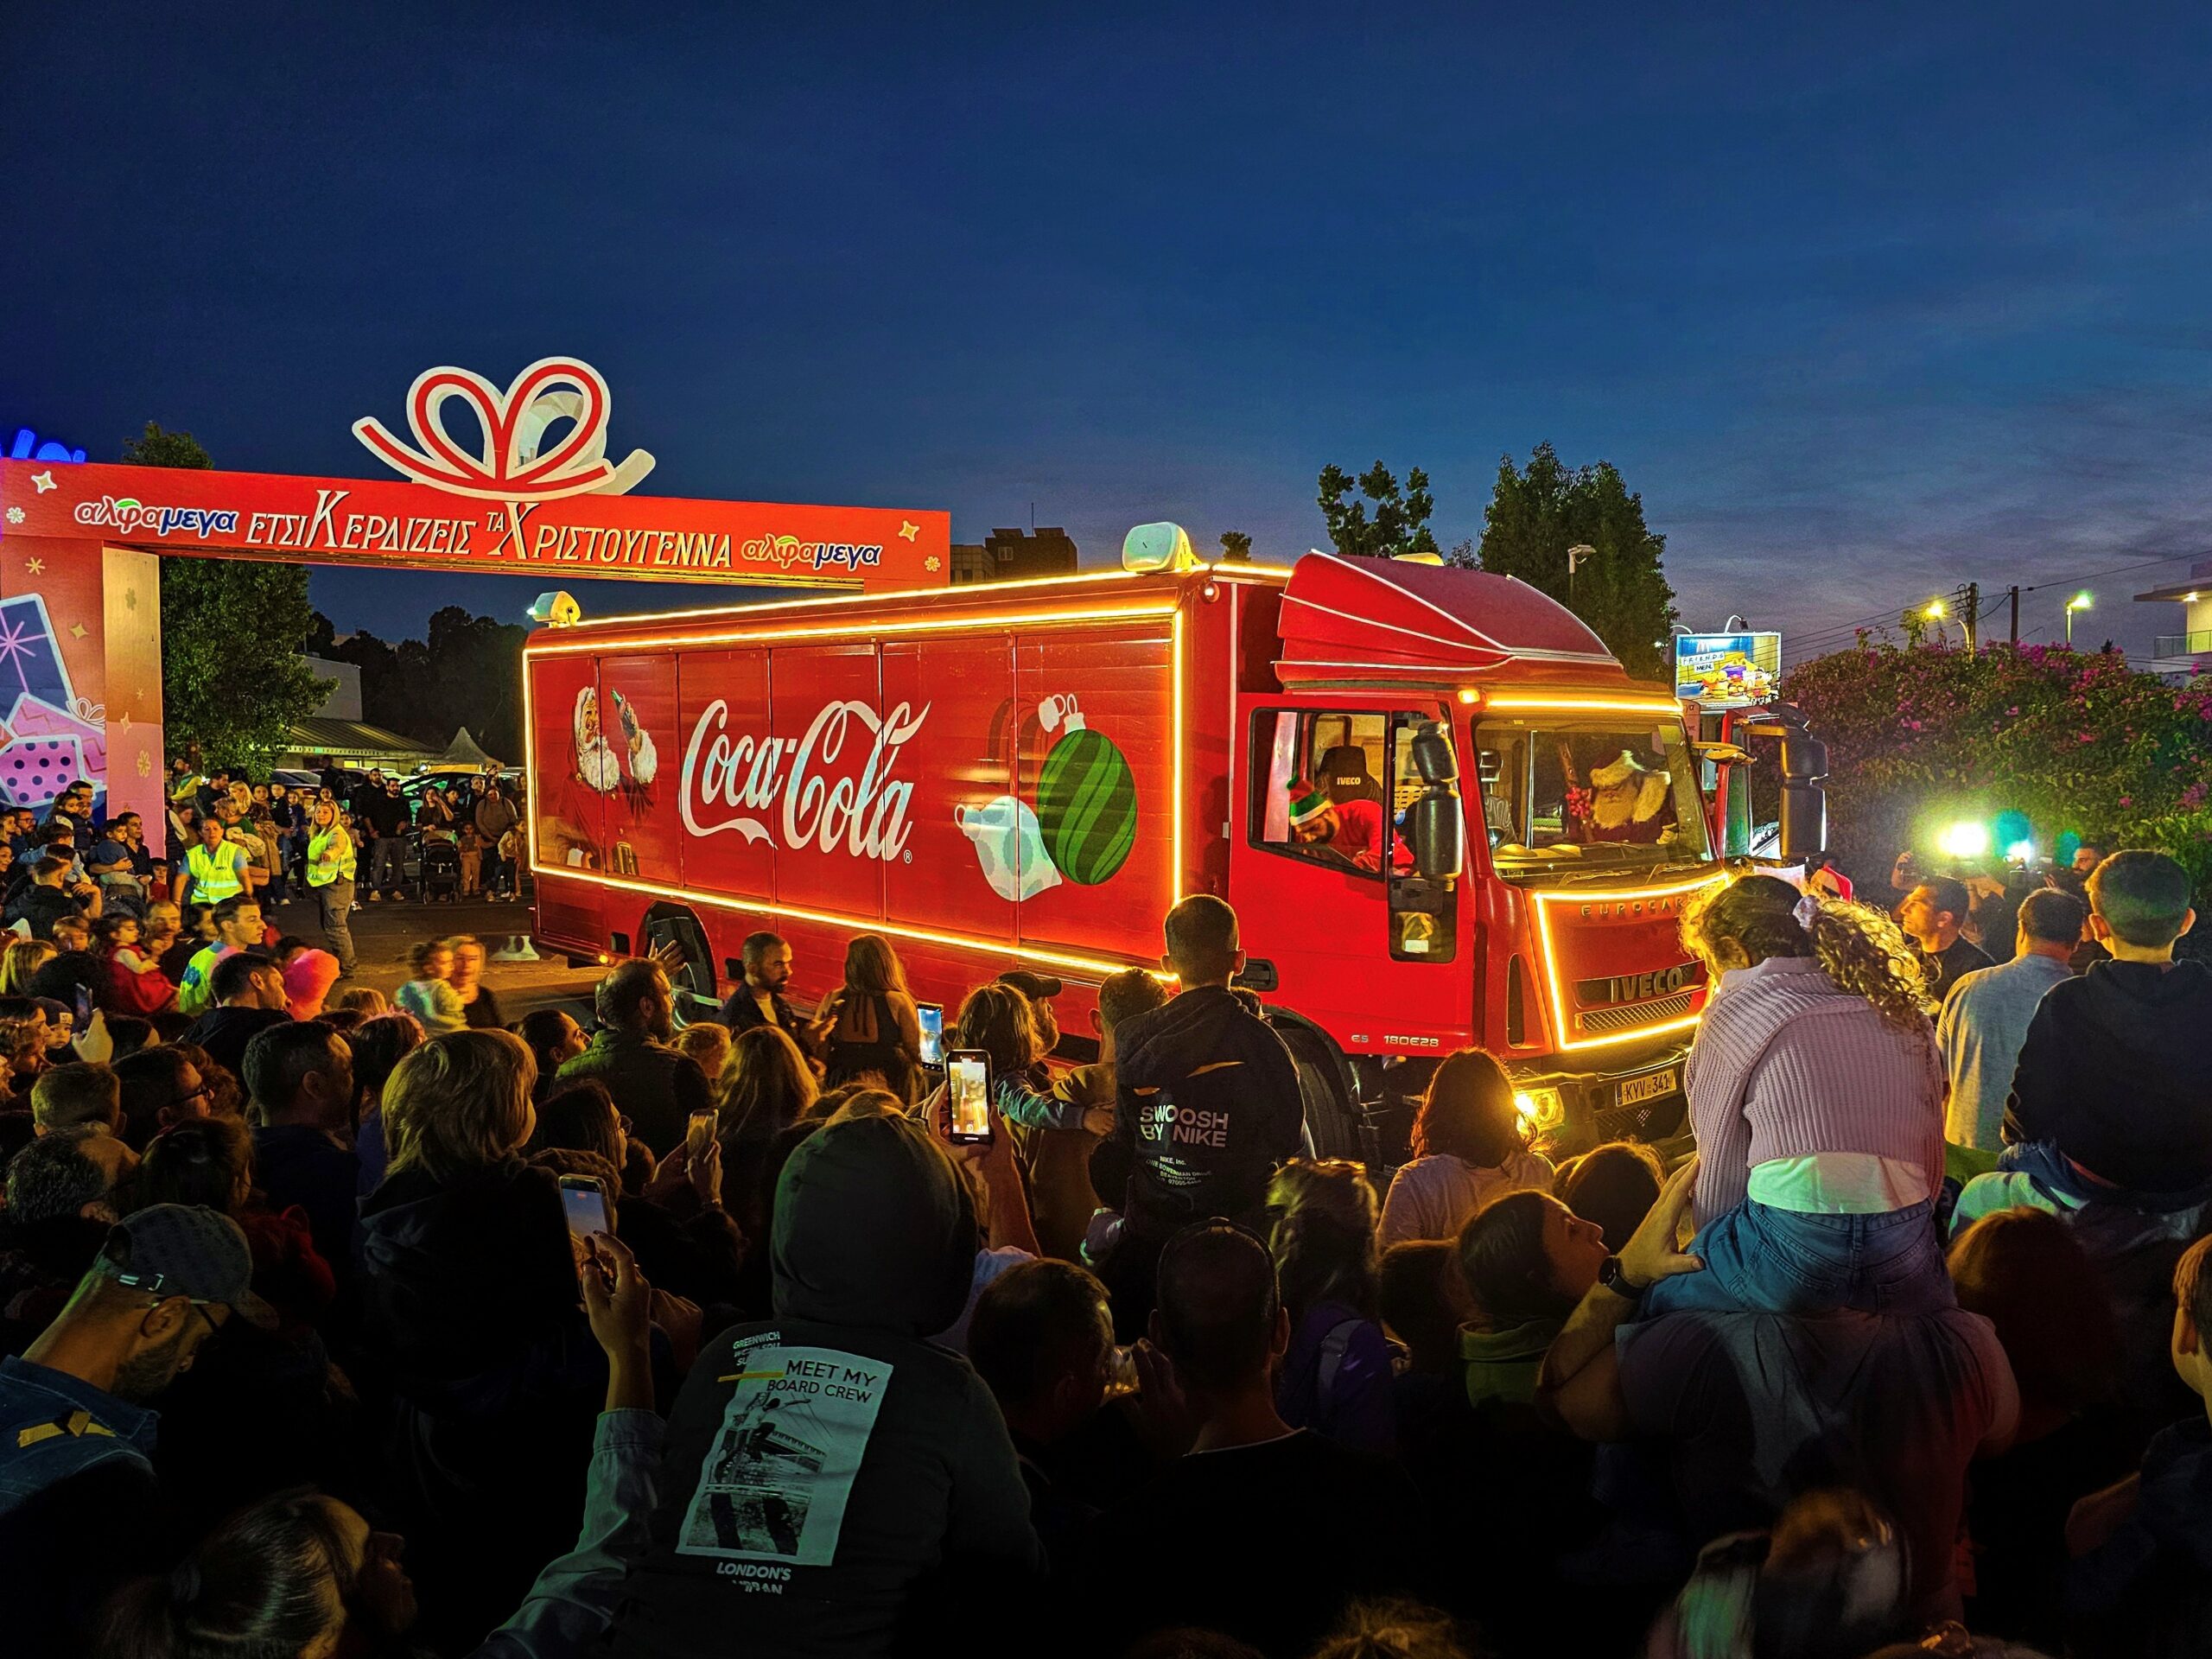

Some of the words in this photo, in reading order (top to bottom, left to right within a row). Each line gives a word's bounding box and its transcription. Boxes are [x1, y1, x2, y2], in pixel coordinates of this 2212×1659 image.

[679, 697, 931, 862] Coca-Cola
[1337, 777, 1361, 785] IVECO
[1580, 897, 1686, 918] EUROCAR
[1611, 967, 1683, 1004] IVECO
[1383, 1035, 1439, 1047] 180E28
[1625, 1080, 1646, 1102] KYV
[1652, 1073, 1670, 1094] 341
[1140, 1104, 1230, 1130] SWOOSH
[1141, 1122, 1165, 1141] BY
[1173, 1124, 1228, 1148] NIKE
[733, 1330, 781, 1350] GREENWICH
[785, 1359, 840, 1380] MEET
[843, 1367, 878, 1388] MY
[766, 1379, 820, 1395] BOARD
[824, 1383, 873, 1404] CREW
[715, 1561, 792, 1581] LONDON'S
